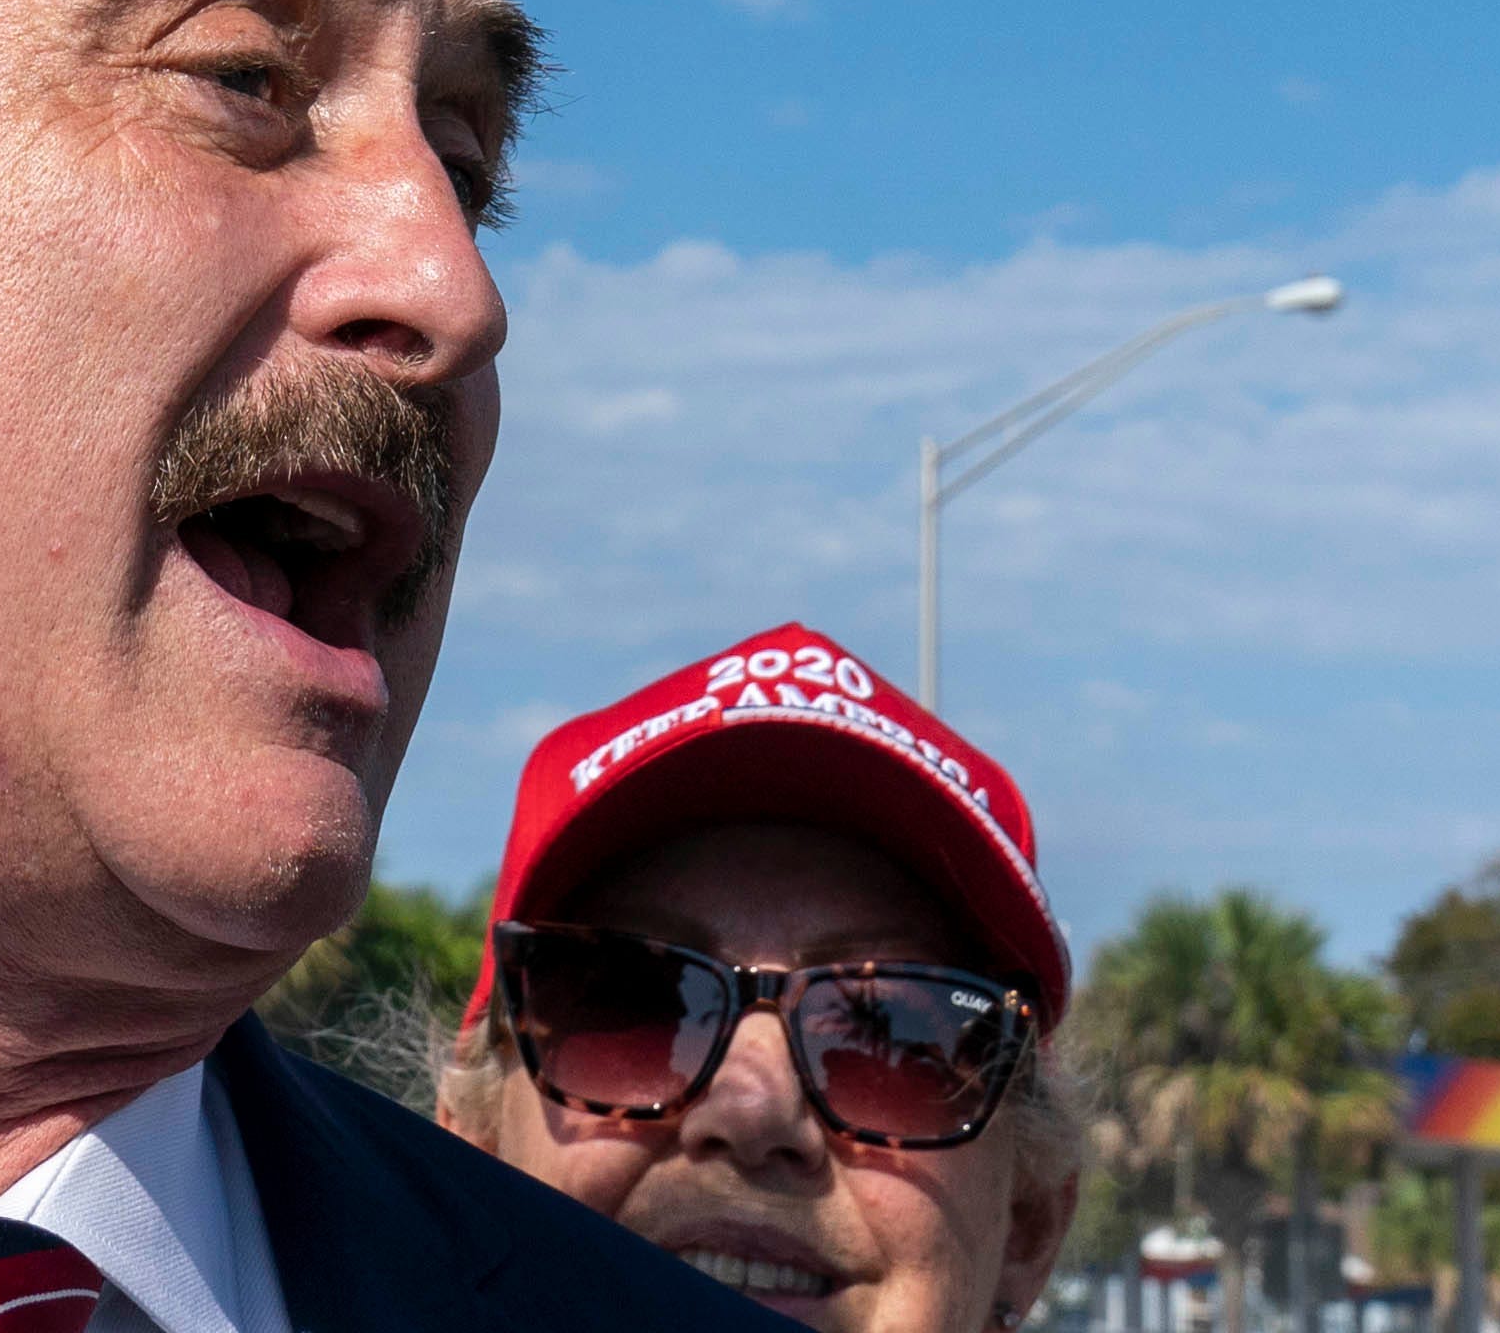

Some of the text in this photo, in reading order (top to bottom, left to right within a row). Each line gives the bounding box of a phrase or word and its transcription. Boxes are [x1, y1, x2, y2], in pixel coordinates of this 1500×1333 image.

[706, 645, 873, 701] 2020
[568, 694, 721, 795] KEEP
[950, 990, 993, 1014] QUAY
